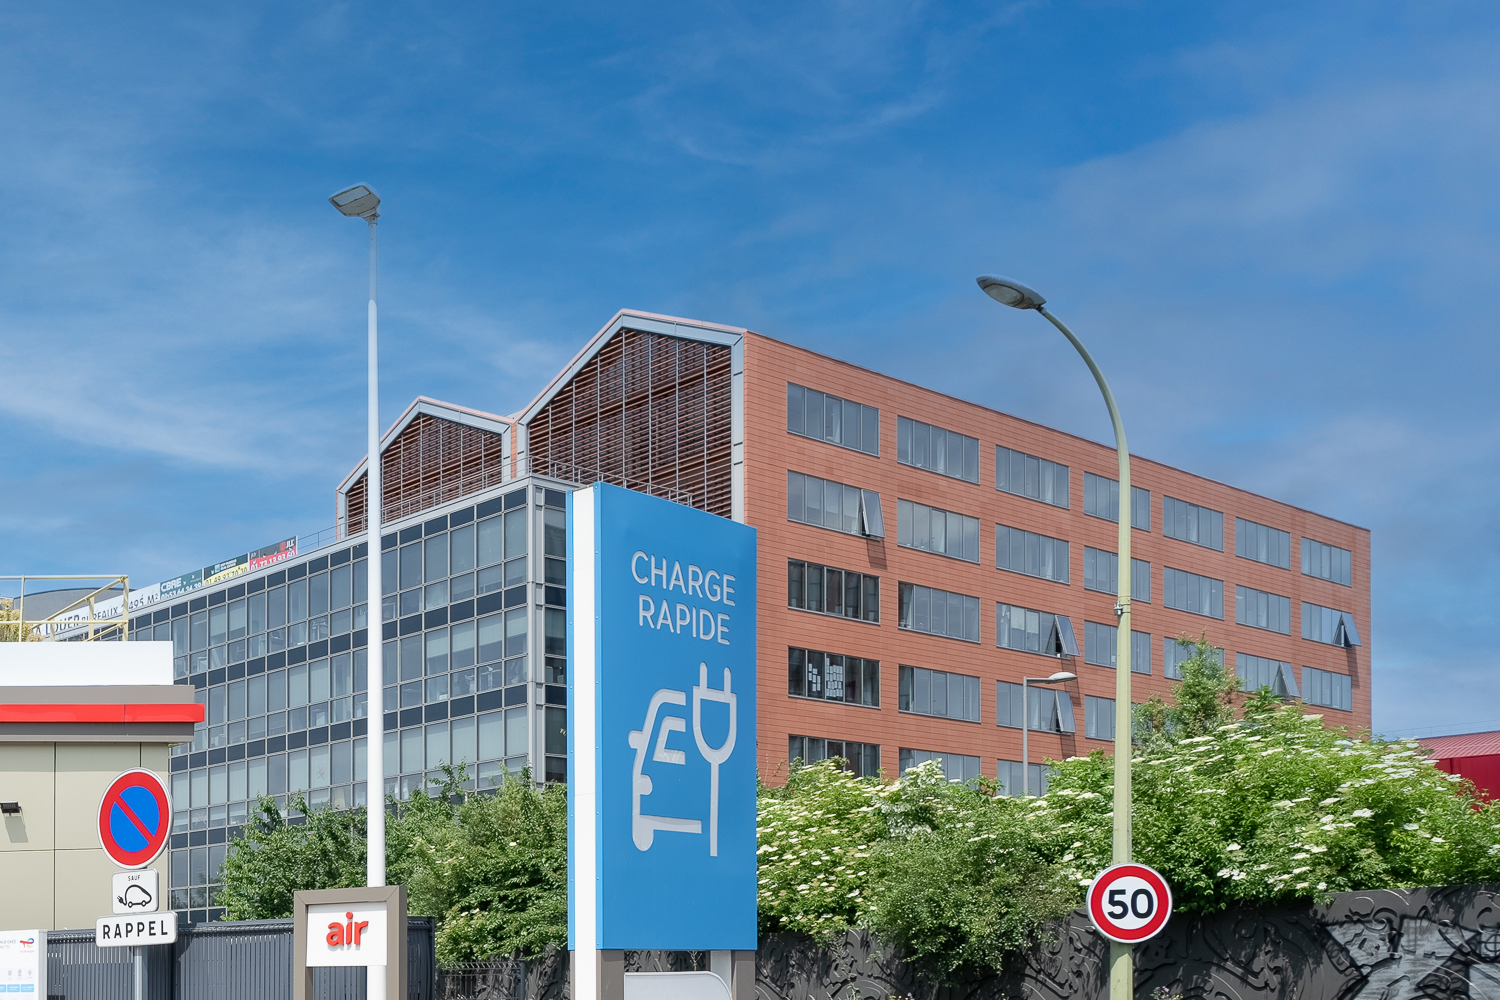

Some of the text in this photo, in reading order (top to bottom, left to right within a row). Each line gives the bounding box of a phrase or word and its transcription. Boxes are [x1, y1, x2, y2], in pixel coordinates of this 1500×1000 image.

[160, 577, 182, 592] CBRE
[631, 550, 736, 607] CHARGE
[638, 594, 731, 645] RAPIDE
[1107, 888, 1154, 920] 50
[103, 920, 168, 939] RAPPEL
[326, 911, 369, 947] air
